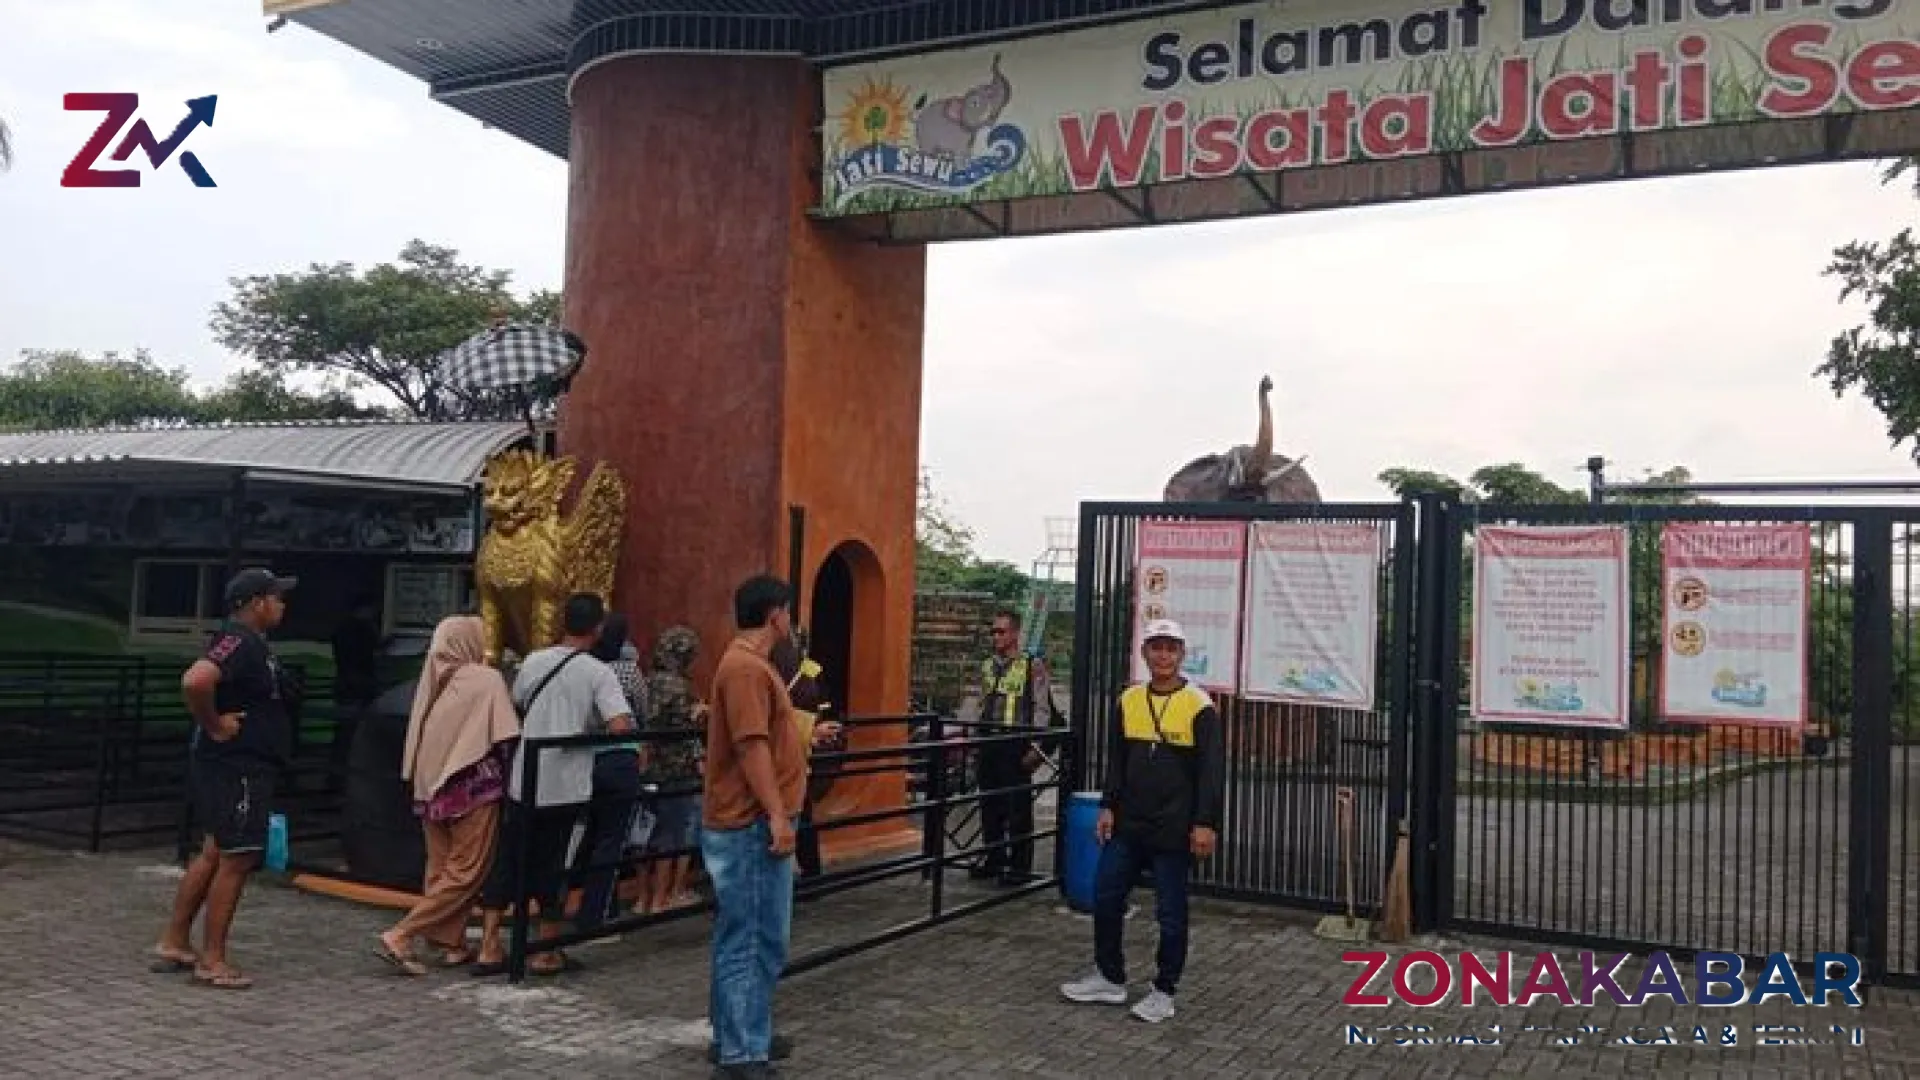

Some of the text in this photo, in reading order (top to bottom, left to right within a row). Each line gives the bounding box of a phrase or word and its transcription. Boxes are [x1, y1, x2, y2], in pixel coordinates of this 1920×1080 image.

[1142, 0, 1488, 90] Selamat
[1059, 90, 1431, 189] Wisata
[1471, 36, 1709, 144] Jati
